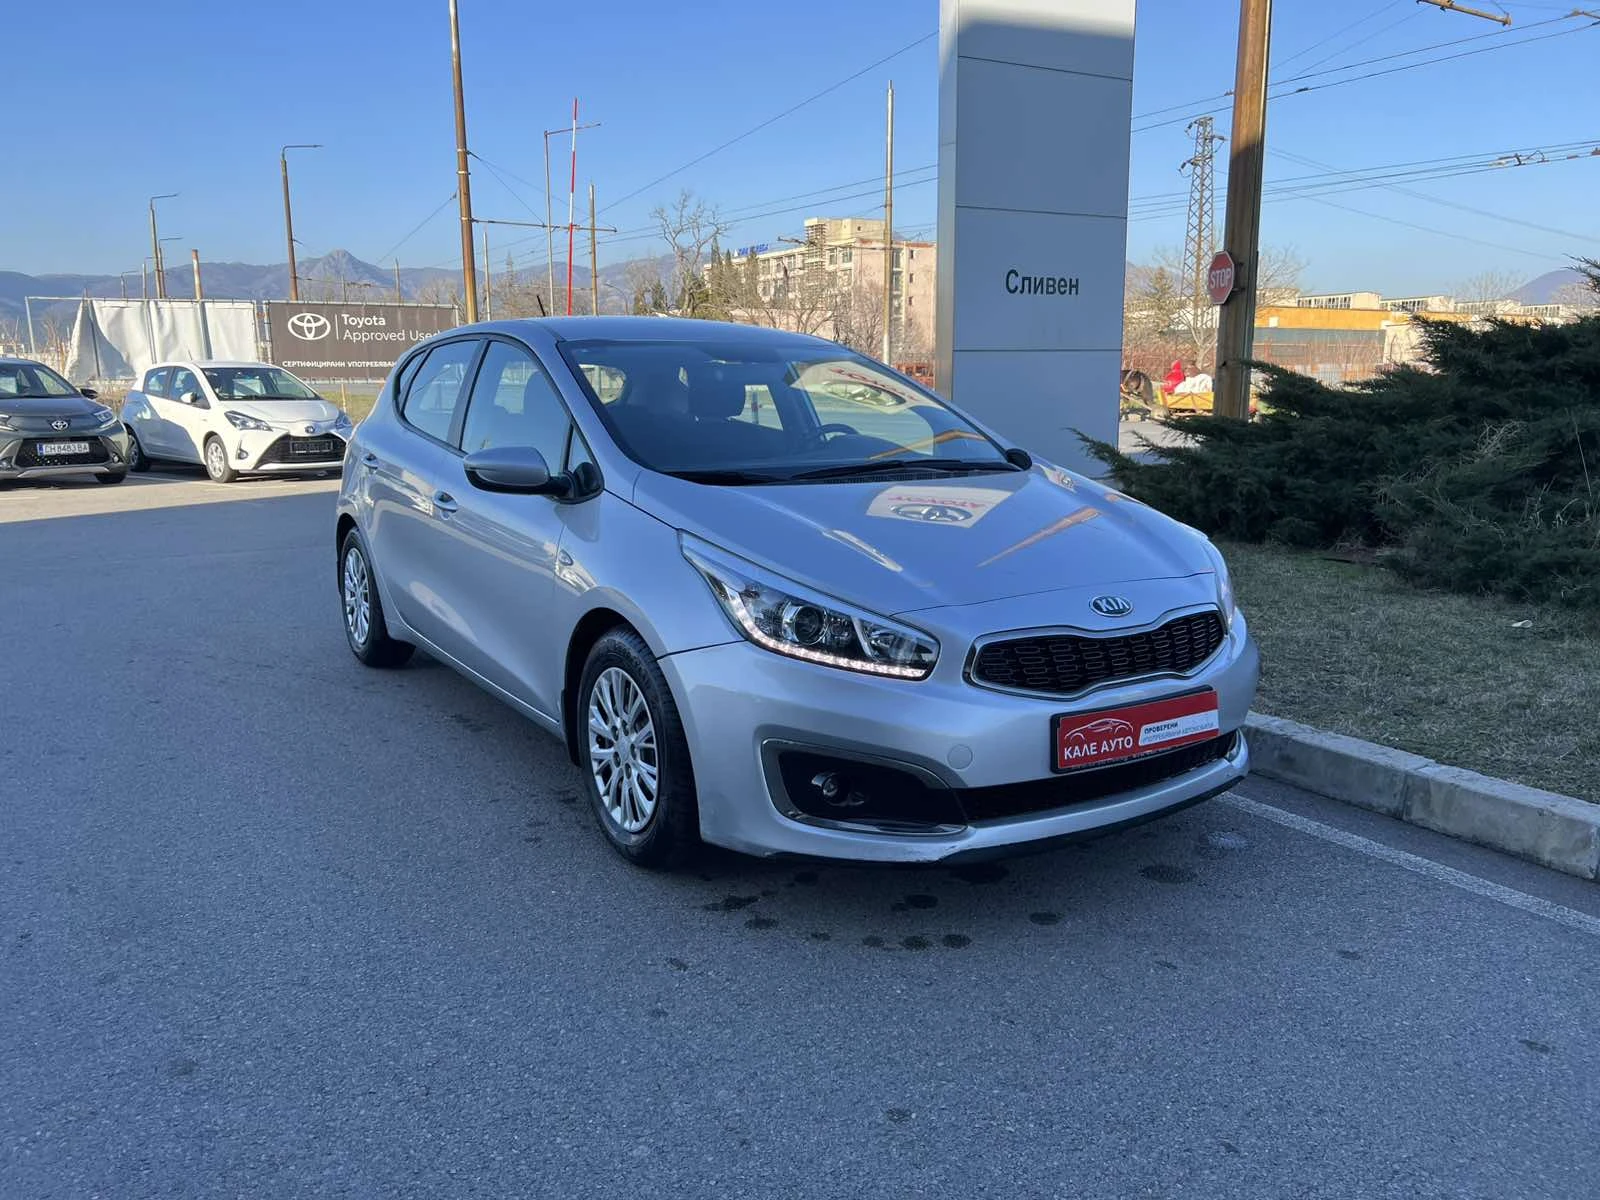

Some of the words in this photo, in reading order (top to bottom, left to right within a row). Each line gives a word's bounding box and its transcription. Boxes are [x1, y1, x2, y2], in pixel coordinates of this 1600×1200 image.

[1005, 268, 1079, 296] Сливен
[1210, 268, 1231, 289] STOP
[341, 313, 386, 329] Toyota
[343, 329, 406, 343] Approved
[1096, 598, 1129, 611] KIA
[1144, 721, 1179, 735] ПРОВЕРЕНИ
[1064, 742, 1098, 761] КАЛЕ
[1101, 735, 1134, 754] АУТО
